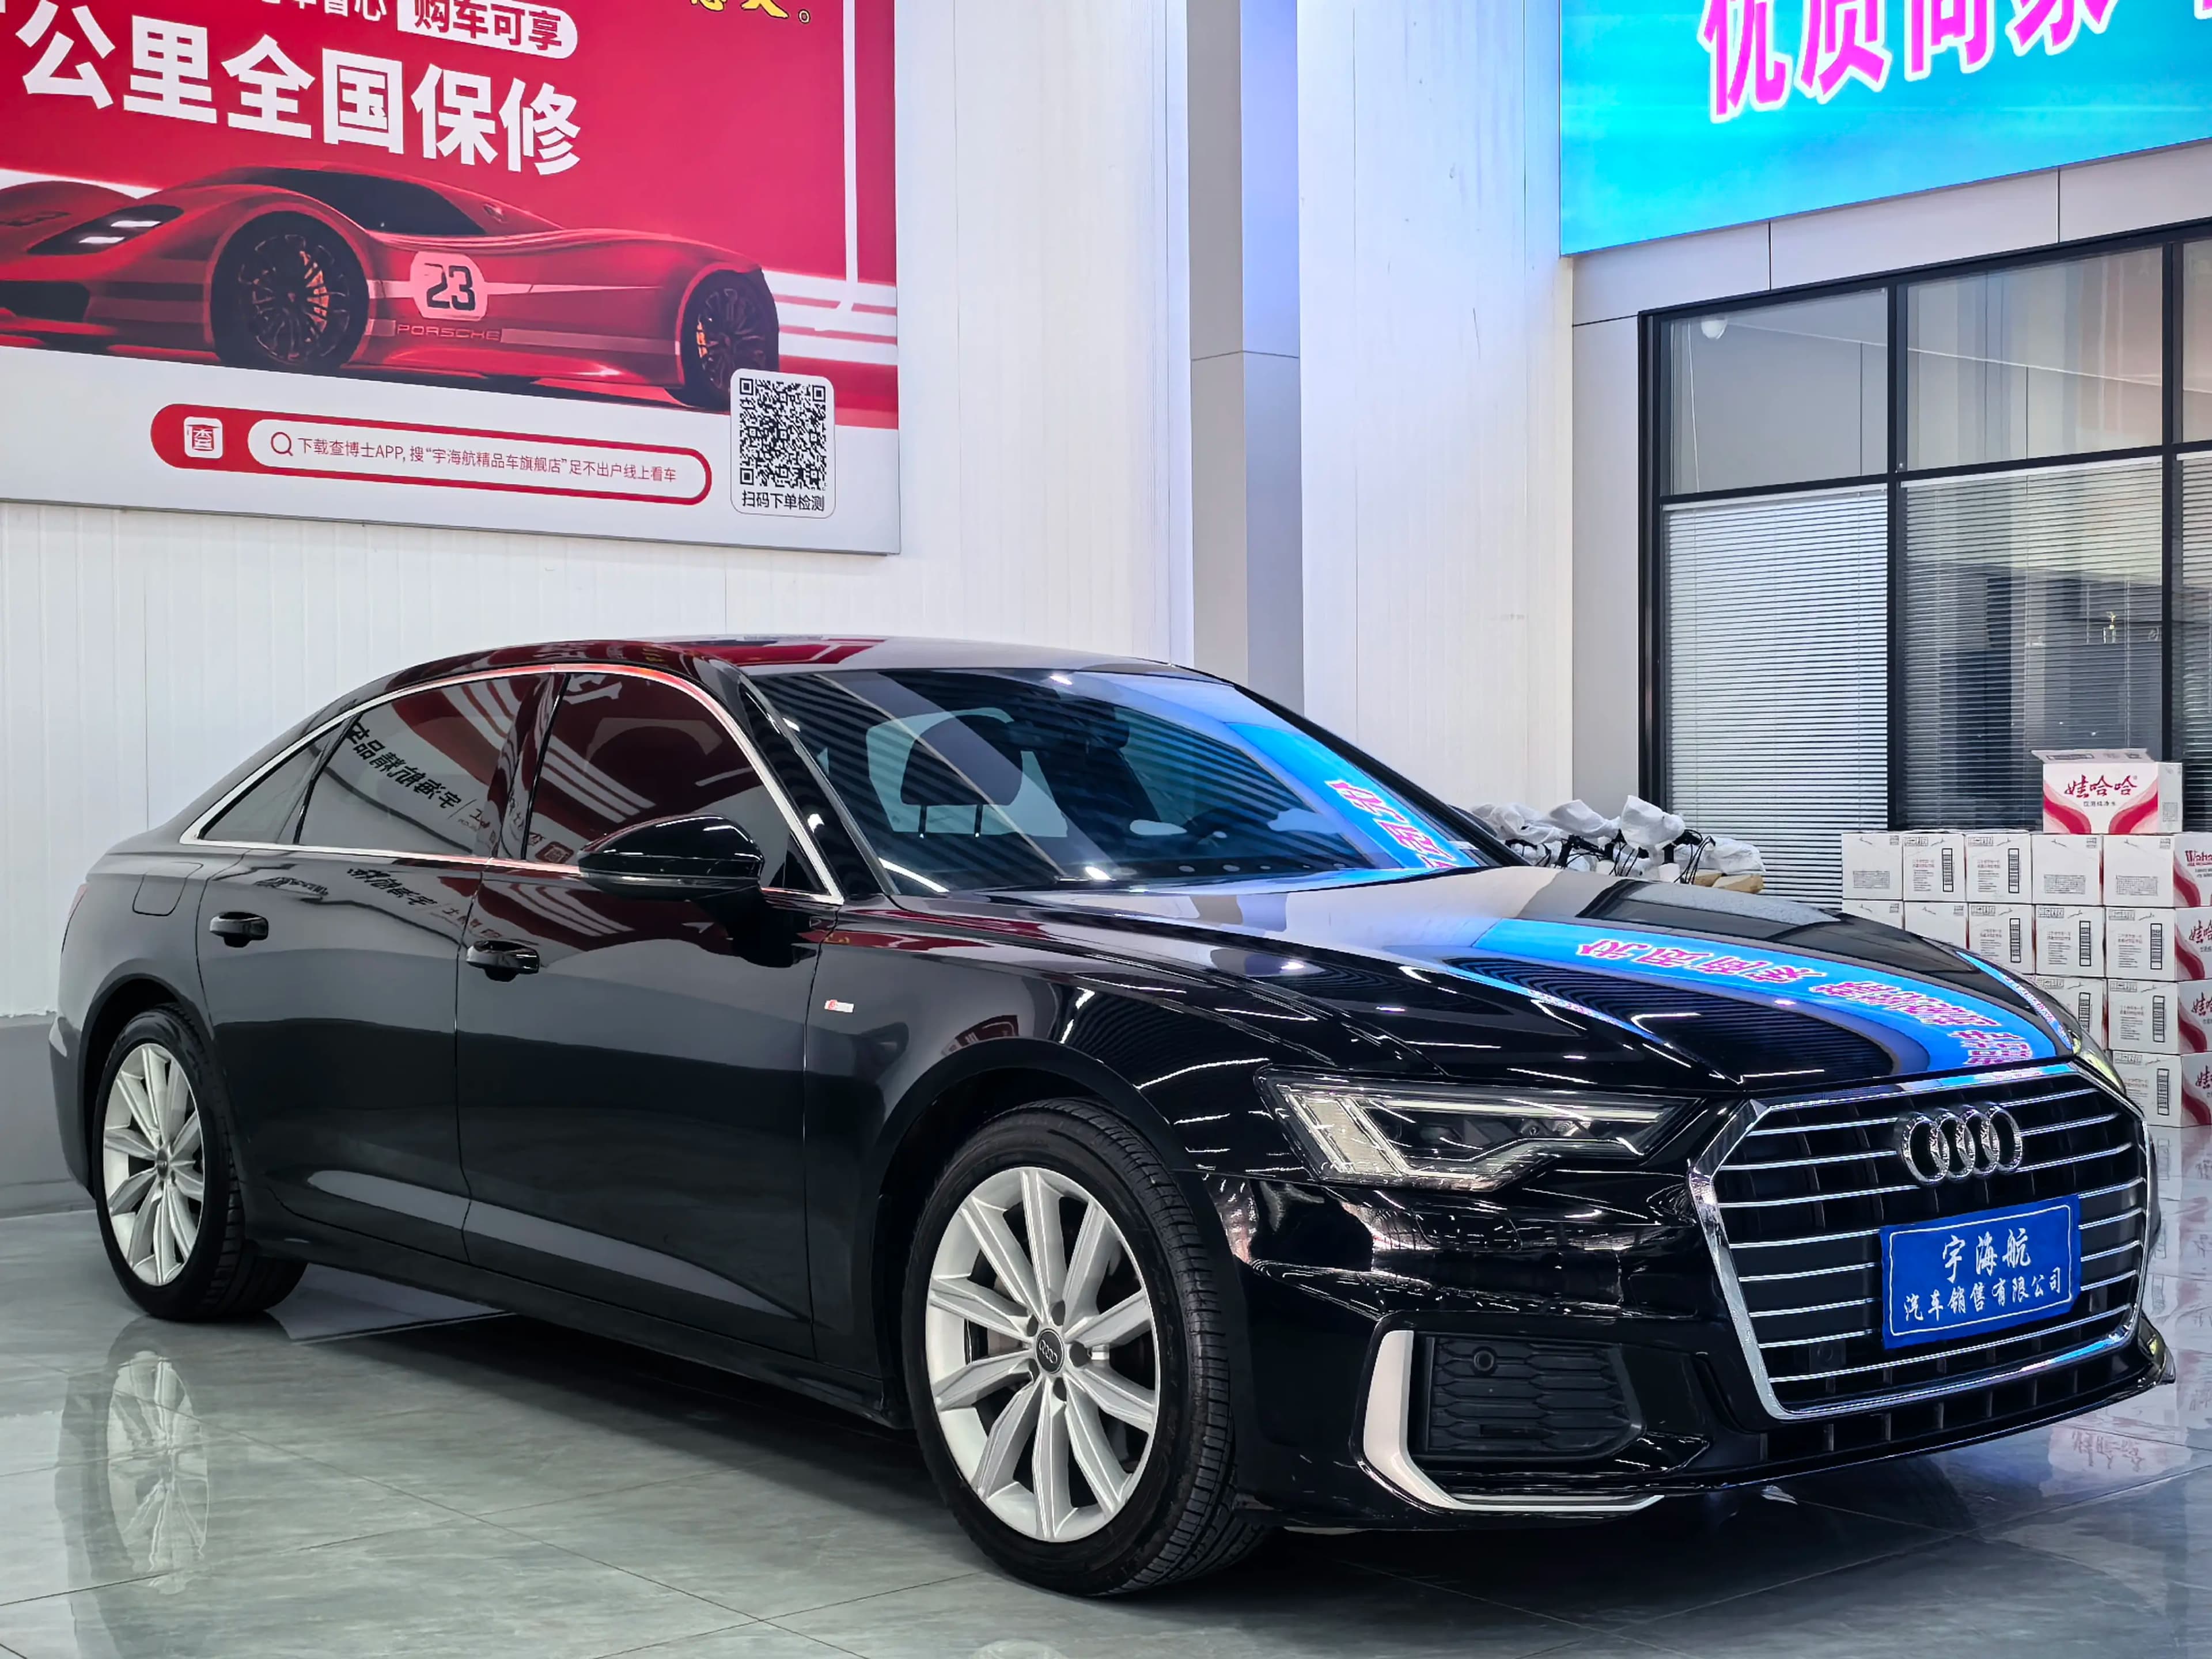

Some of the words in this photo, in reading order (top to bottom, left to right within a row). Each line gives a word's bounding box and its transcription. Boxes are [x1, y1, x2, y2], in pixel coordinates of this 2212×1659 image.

[414, 0, 562, 51] 购车可享
[0, 0, 581, 176] 公里全国保修
[424, 262, 476, 311] 23
[397, 324, 501, 341] PORSCHE
[741, 490, 825, 512] 扫码下单检测
[2064, 774, 2137, 798] 娃哈哈
[1941, 1228, 2032, 1283] 宇海航
[1903, 1267, 2061, 1321] 汽车销售有限公司
